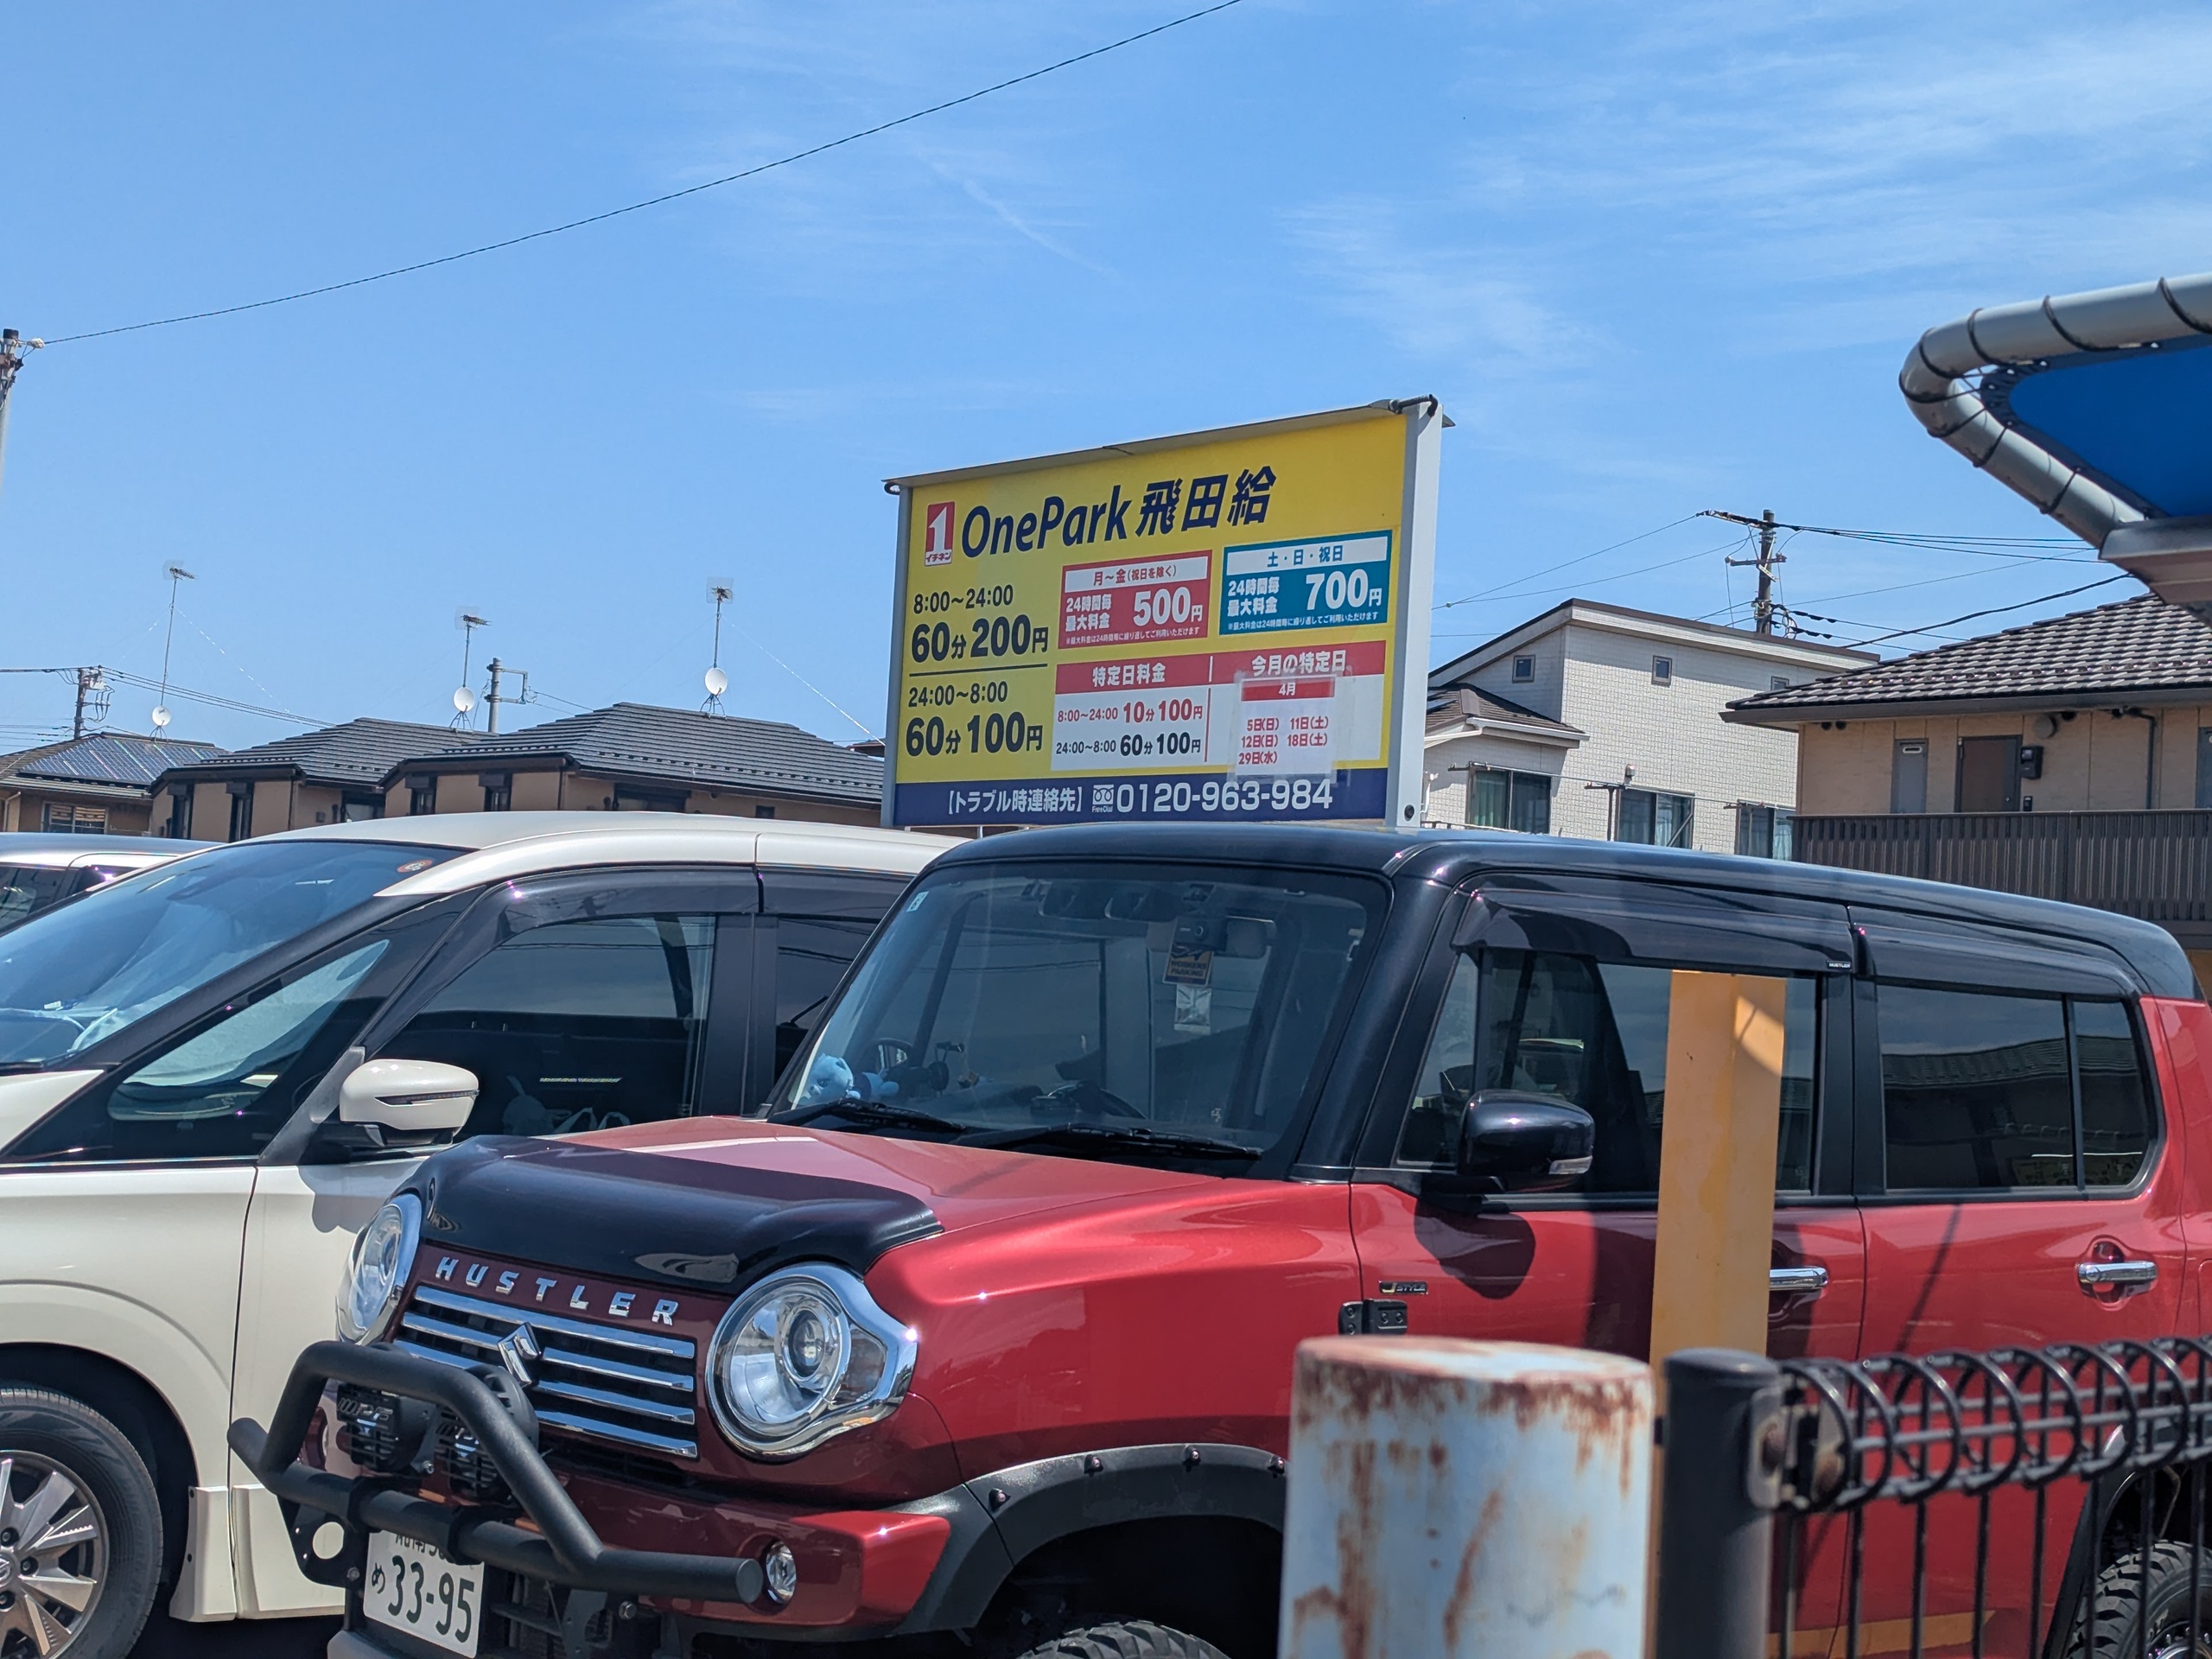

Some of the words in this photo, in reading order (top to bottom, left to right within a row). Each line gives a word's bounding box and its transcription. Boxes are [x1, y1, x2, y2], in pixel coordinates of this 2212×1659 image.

[962, 485, 1132, 557] OnePark
[1135, 466, 1276, 537] 飛田給
[925, 551, 951, 563] イチネン
[1228, 576, 1280, 596] 24時間毎
[1306, 569, 1382, 611] 700円
[1066, 594, 1112, 613] 24時間毎
[1134, 587, 1203, 626] 500円
[1228, 596, 1277, 616] 最大料金
[1065, 613, 1110, 632] 最大料金
[1093, 663, 1166, 687] 特定日料金
[1252, 650, 1346, 677] 今月の特定日
[1279, 682, 1296, 696] 4月
[1117, 779, 1333, 812] 0120-963-984
[435, 1256, 680, 1326] HUSTLER
[372, 1562, 386, 1594] め
[387, 1554, 475, 1643] 33-95
